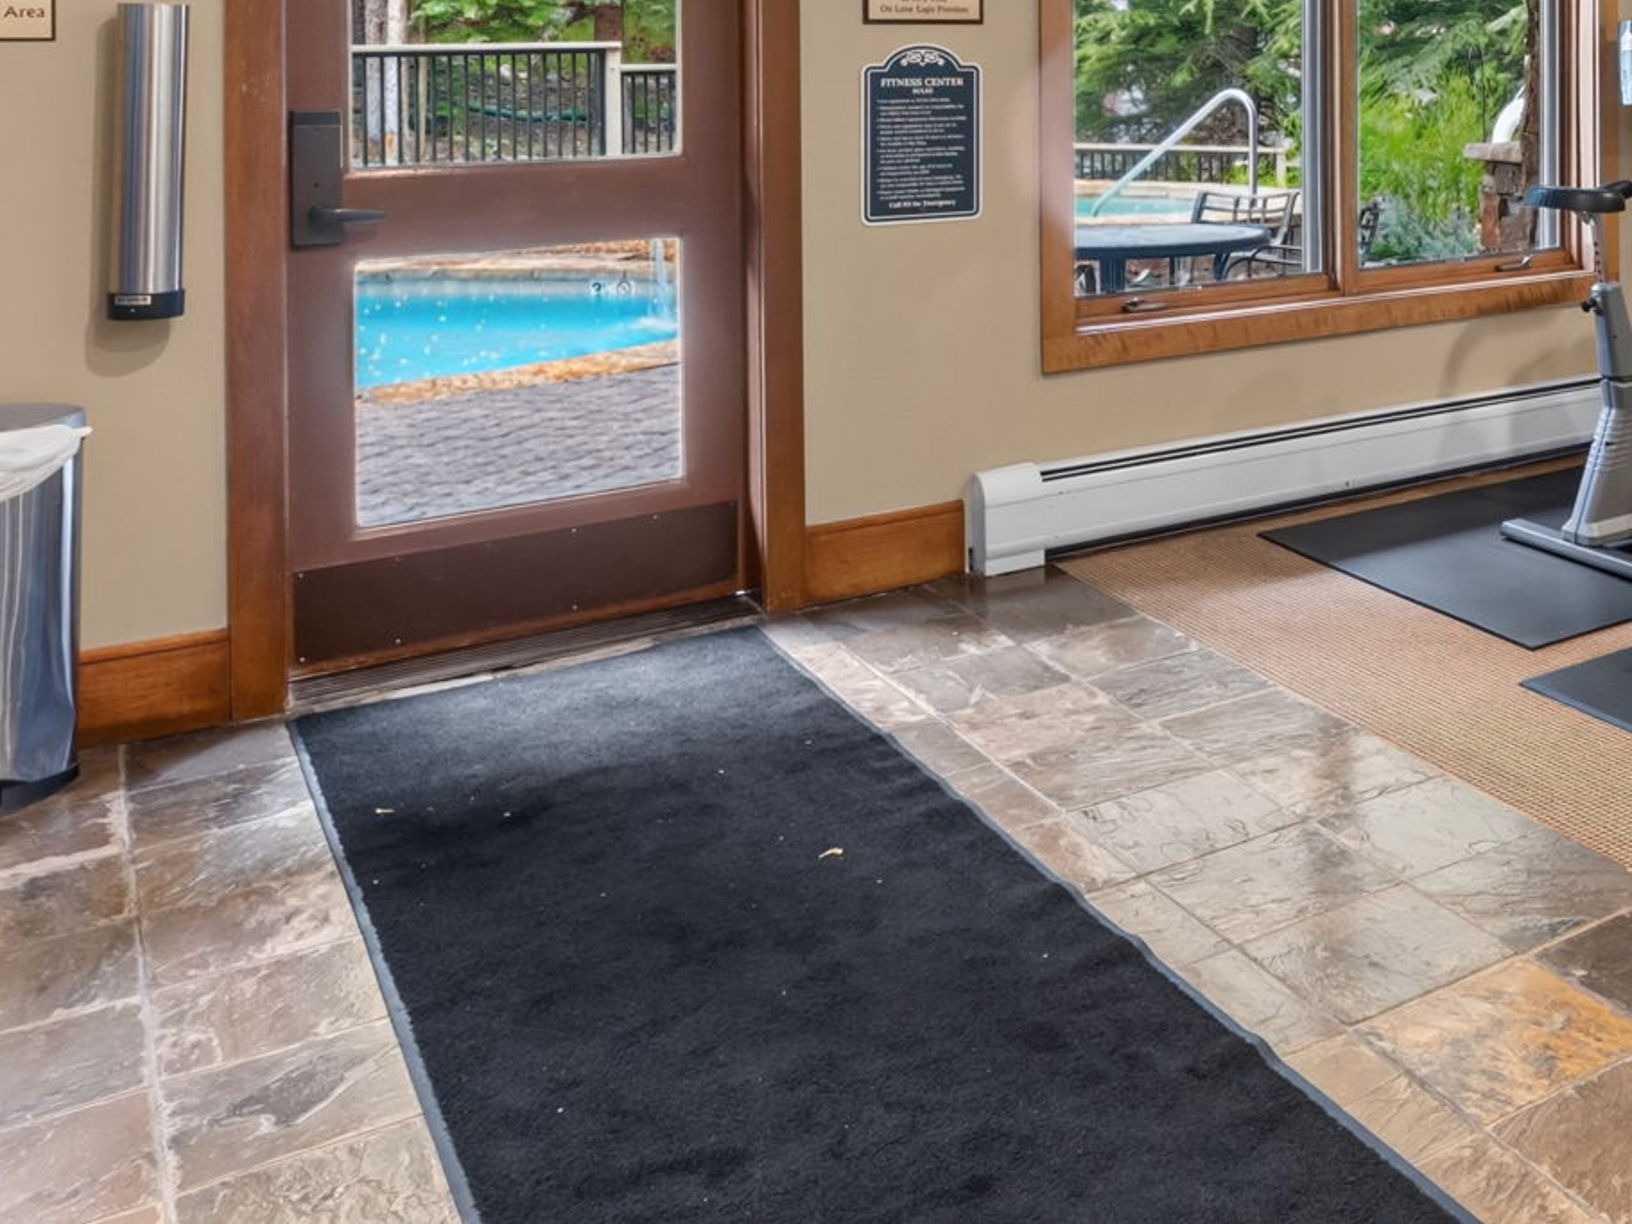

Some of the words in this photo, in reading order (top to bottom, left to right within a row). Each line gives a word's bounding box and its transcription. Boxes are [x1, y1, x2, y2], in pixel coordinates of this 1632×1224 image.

[4, 6, 45, 18] Area
[880, 78, 922, 88] FITNESS
[924, 78, 964, 87] CENTER
